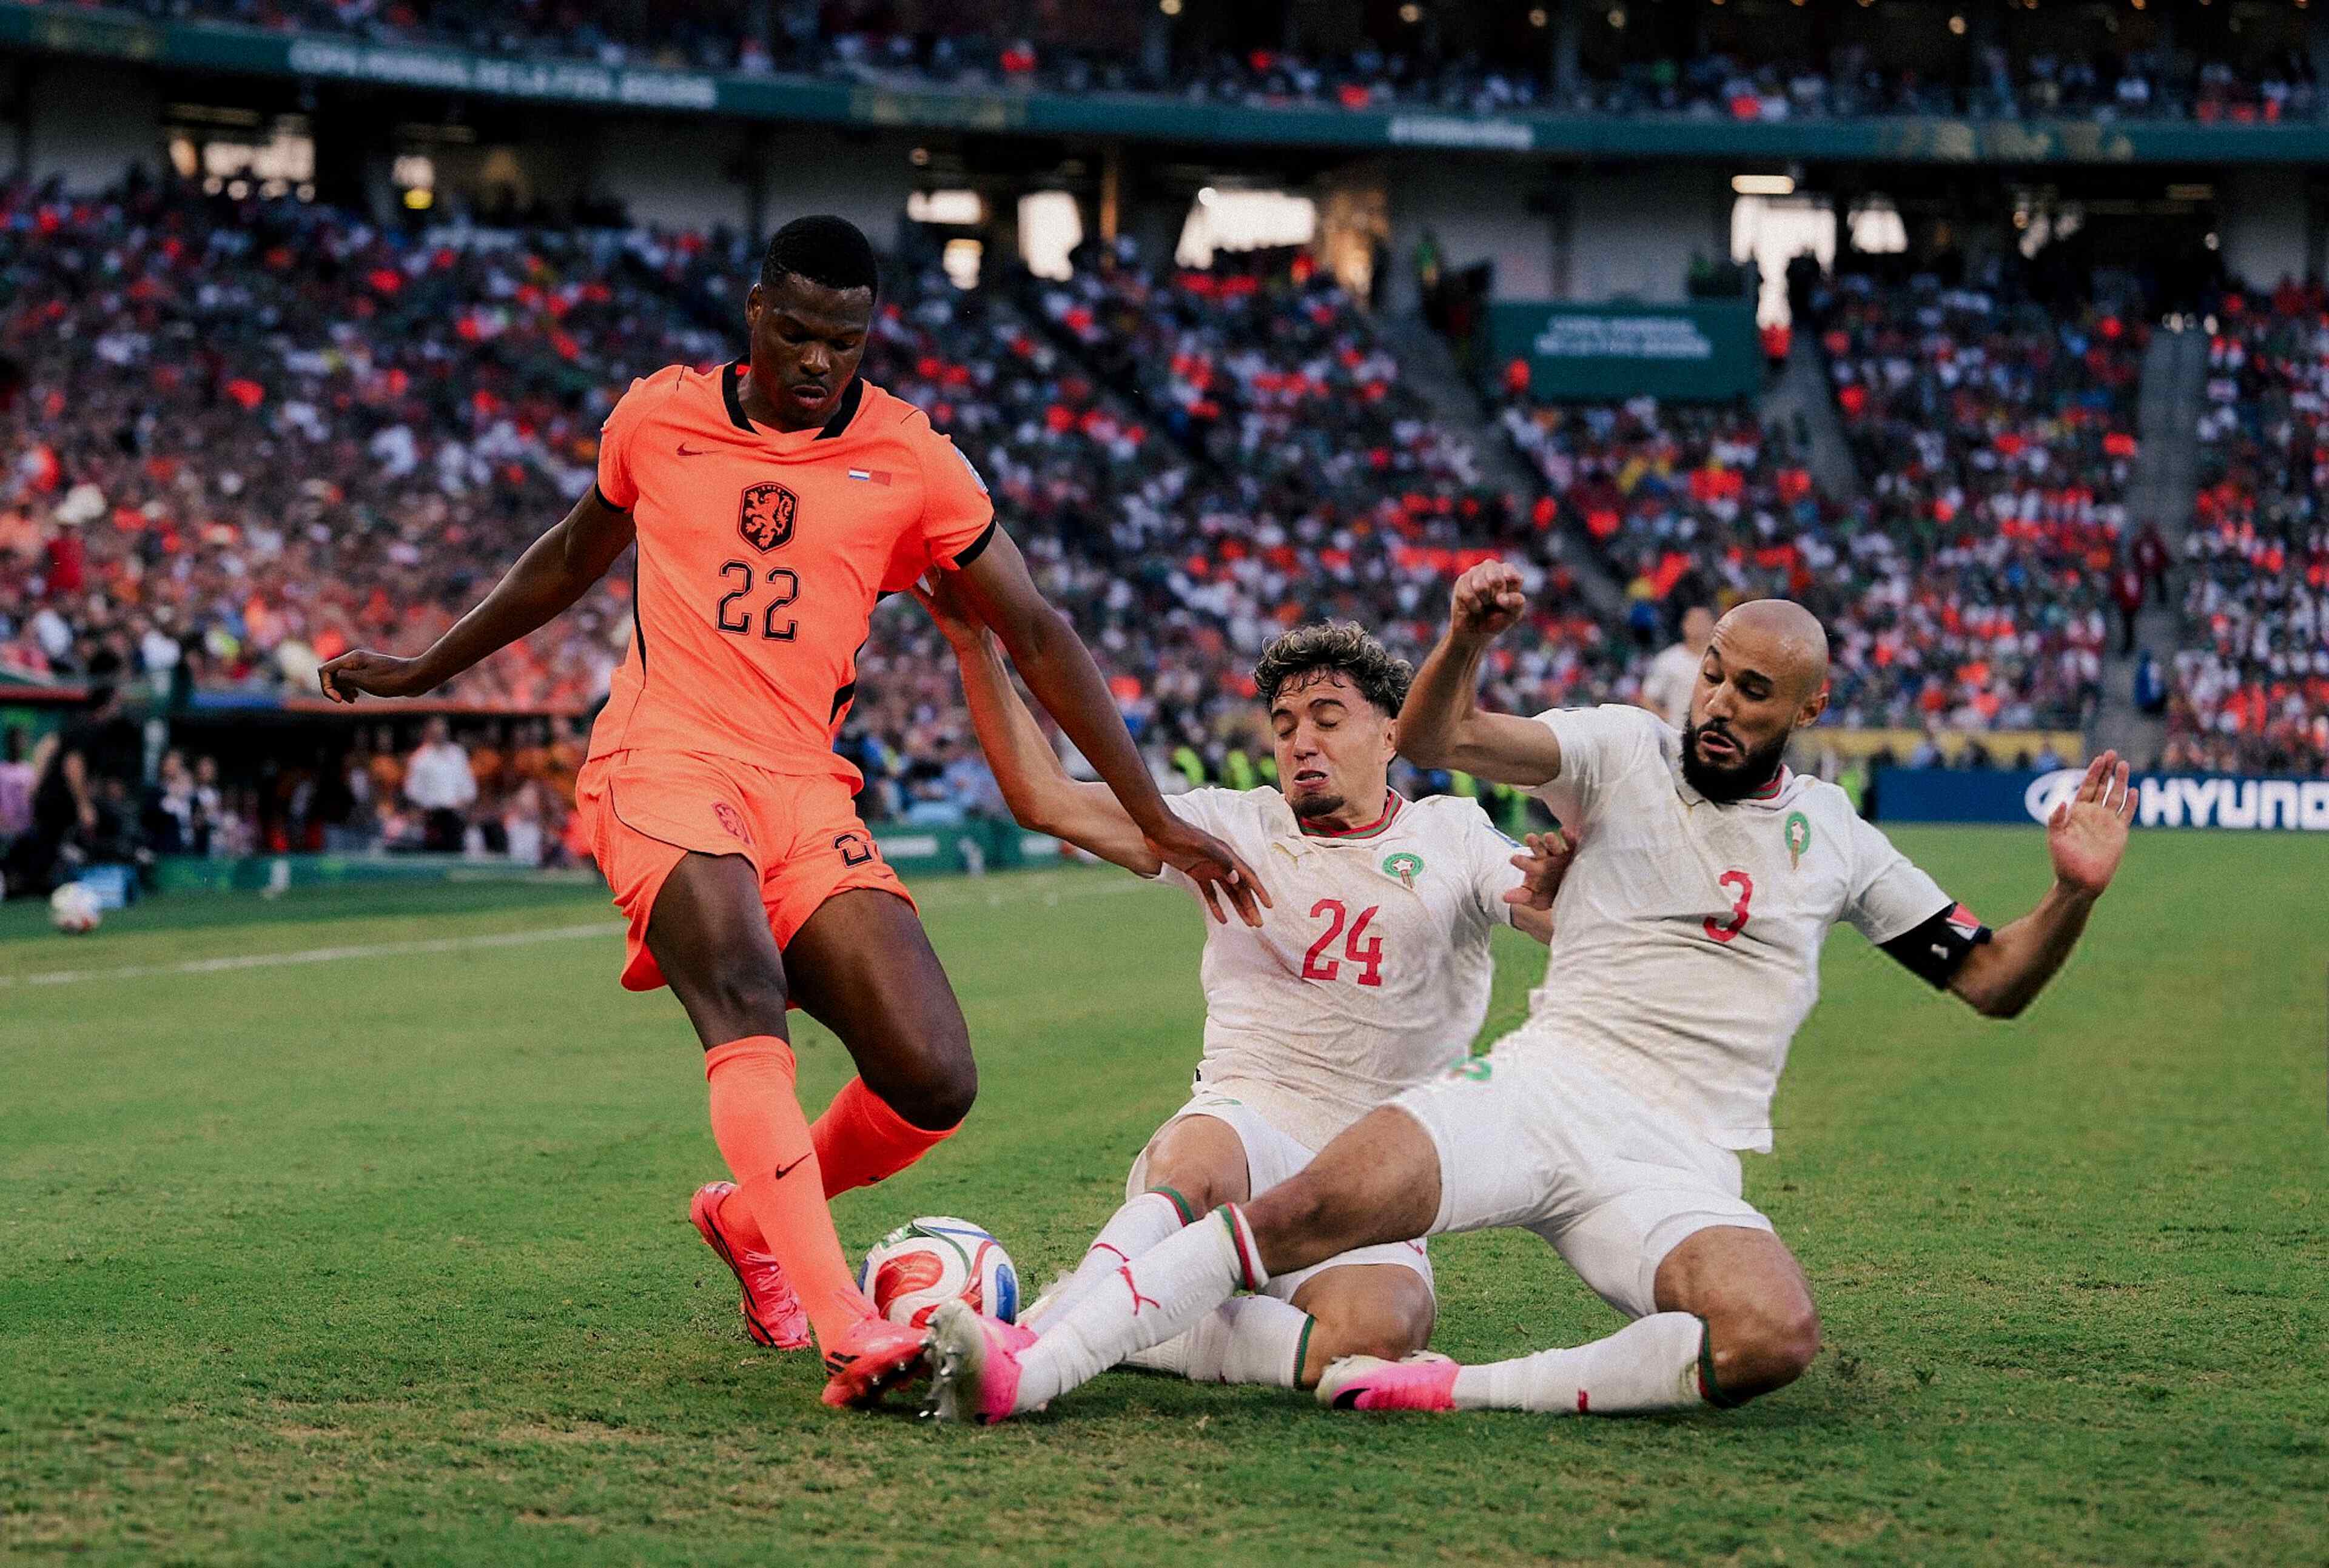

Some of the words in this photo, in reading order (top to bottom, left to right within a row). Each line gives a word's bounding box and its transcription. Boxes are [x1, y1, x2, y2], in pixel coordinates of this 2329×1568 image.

[716, 560, 801, 642] 22
[1301, 899, 1383, 987] 24
[1703, 871, 1753, 942] 3
